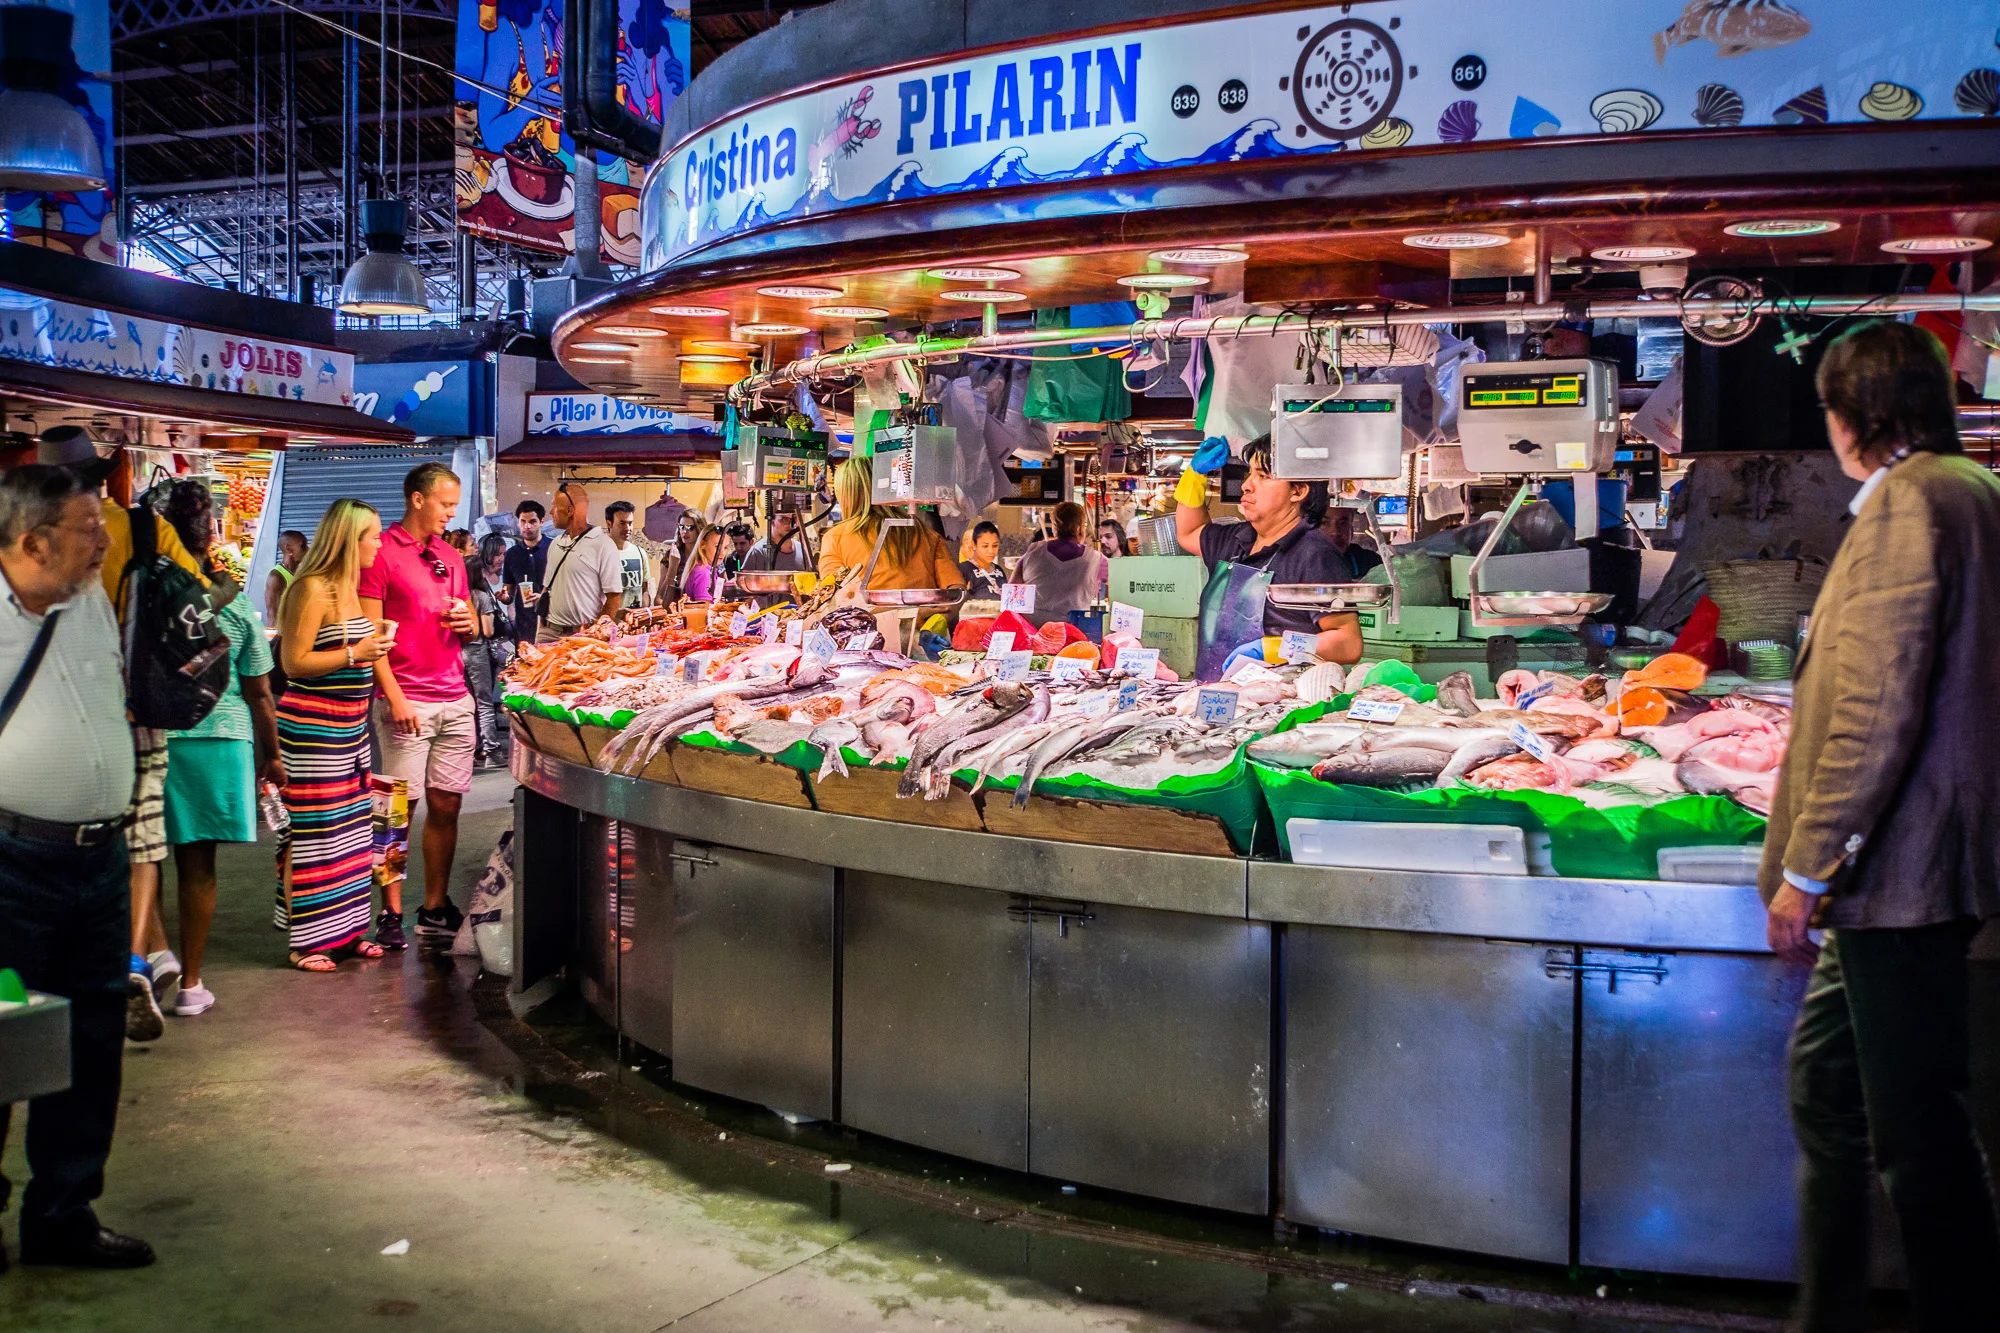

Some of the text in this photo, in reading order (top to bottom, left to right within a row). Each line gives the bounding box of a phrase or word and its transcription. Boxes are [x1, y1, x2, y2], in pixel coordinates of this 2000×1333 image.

[1455, 65, 1482, 81] 861
[896, 43, 1142, 155] PILARIN
[1173, 94, 1198, 109] 839
[1220, 89, 1246, 105] 838
[685, 122, 797, 212] Cristina
[220, 340, 303, 379] JOLIS
[551, 398, 596, 421] Pilar
[602, 396, 608, 420] i
